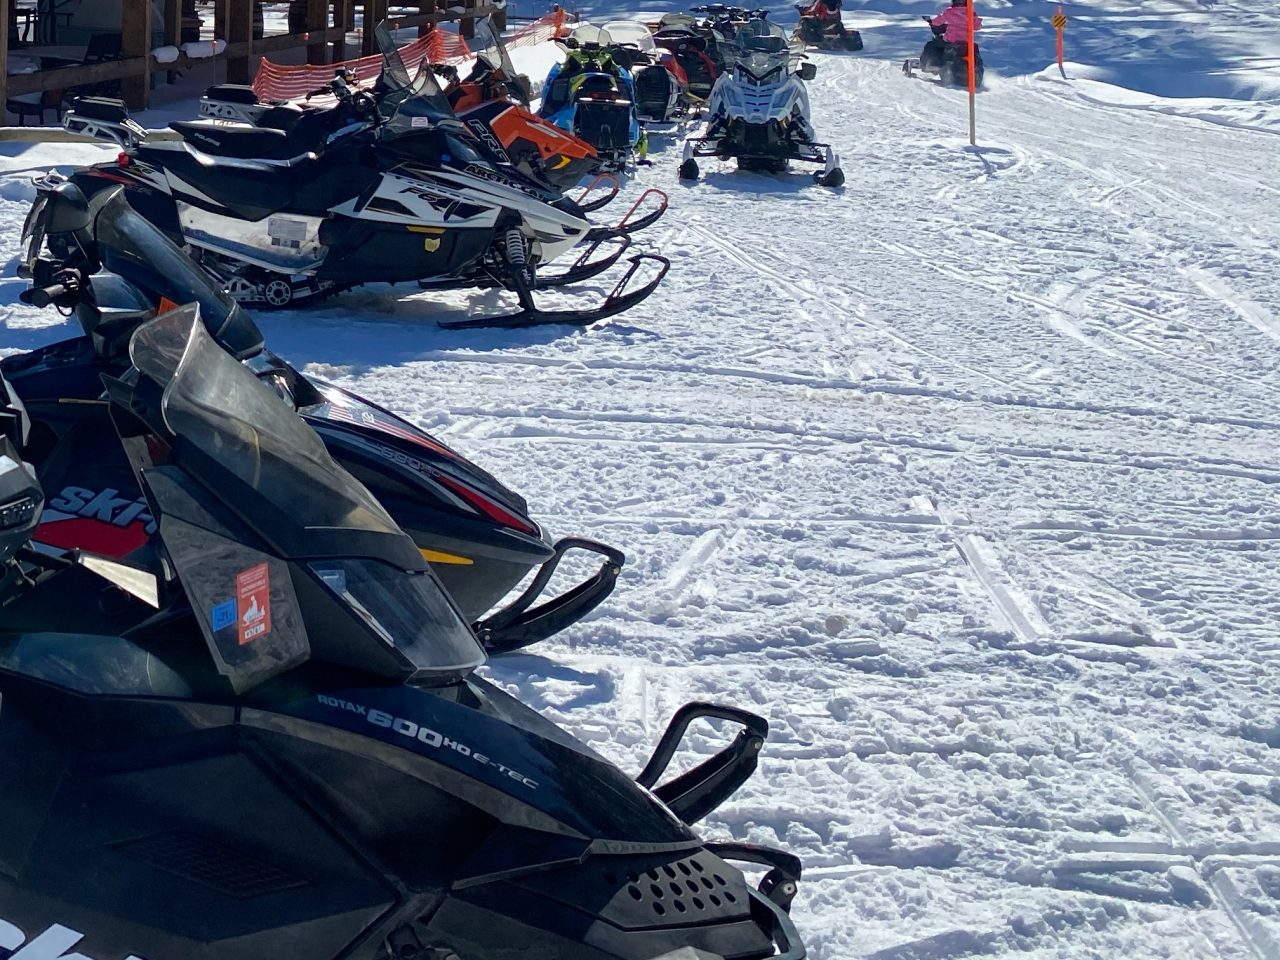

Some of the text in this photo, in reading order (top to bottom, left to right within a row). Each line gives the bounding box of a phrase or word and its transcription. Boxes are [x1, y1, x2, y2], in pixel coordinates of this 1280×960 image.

[463, 164, 519, 189] ARCTIC
[317, 694, 367, 716] ROTAX
[366, 708, 443, 748] 600
[472, 752, 540, 790] E-TEC
